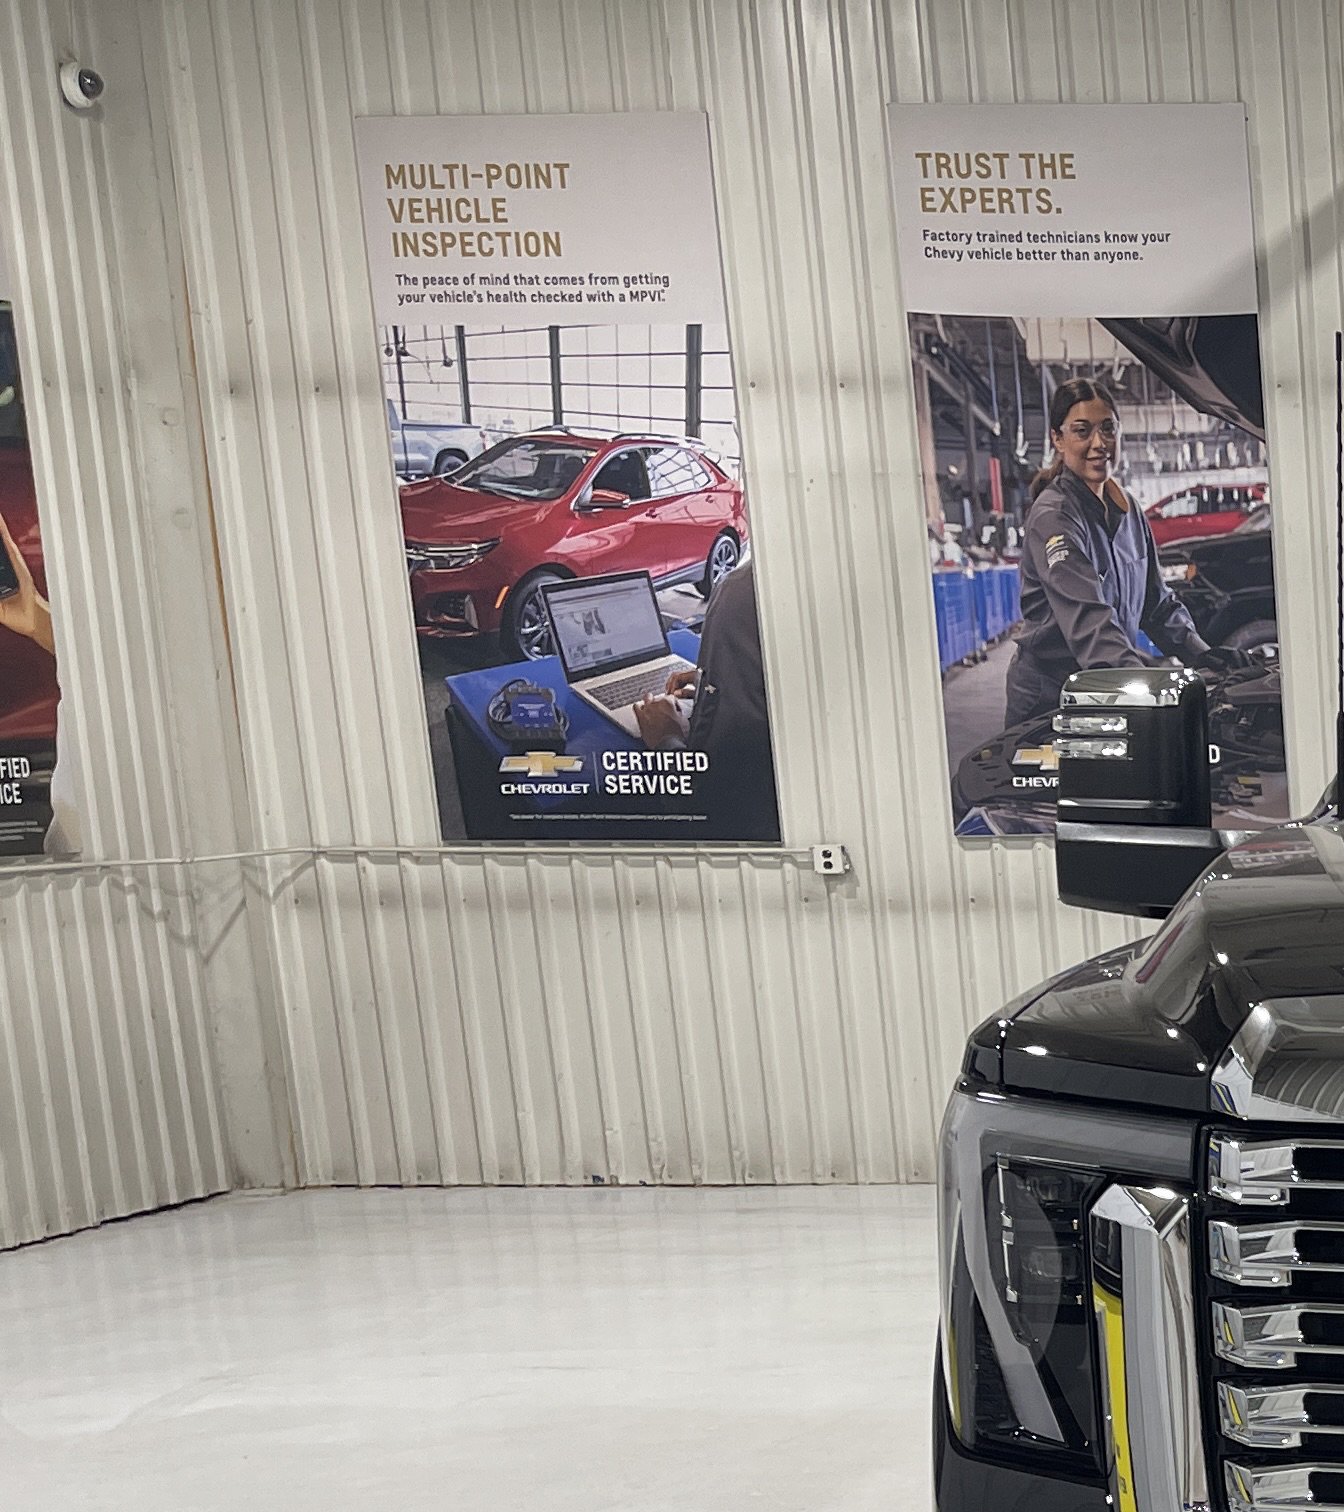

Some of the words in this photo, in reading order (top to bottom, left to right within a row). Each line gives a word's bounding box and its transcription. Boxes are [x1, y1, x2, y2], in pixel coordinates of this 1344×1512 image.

[384, 163, 570, 190] MULTI-POINT
[914, 152, 1010, 180] TRUST
[1018, 152, 1077, 180] THE
[386, 197, 509, 224] VEHICLE
[919, 186, 1063, 215] EXPERTS.
[390, 231, 563, 258] INSPECTION
[922, 229, 972, 245] Factory
[976, 230, 1023, 244] trained
[1026, 230, 1101, 244] technicians
[1104, 230, 1138, 244] know
[1141, 232, 1171, 246] your
[923, 246, 964, 262] Chevy
[966, 246, 1013, 261] vehicle
[1016, 247, 1056, 261] better
[1060, 247, 1091, 261] than
[1093, 249, 1145, 264] anyone.
[395, 273, 419, 287] The
[422, 275, 459, 289] peace
[462, 273, 476, 287] of
[479, 273, 510, 286] mind
[513, 273, 541, 286] that
[543, 275, 585, 286] comes
[588, 273, 620, 286] from
[622, 272, 670, 288] getting
[397, 292, 426, 306] your
[429, 290, 484, 304] vehicle's
[486, 290, 527, 303] health
[530, 290, 583, 303] checked
[586, 290, 615, 303] with
[618, 293, 627, 303] a
[601, 750, 709, 773] CERTIFIED
[500, 782, 590, 796] CHEVROLET
[604, 774, 693, 796] SERVICE
[1012, 776, 1059, 788] CHEVR
